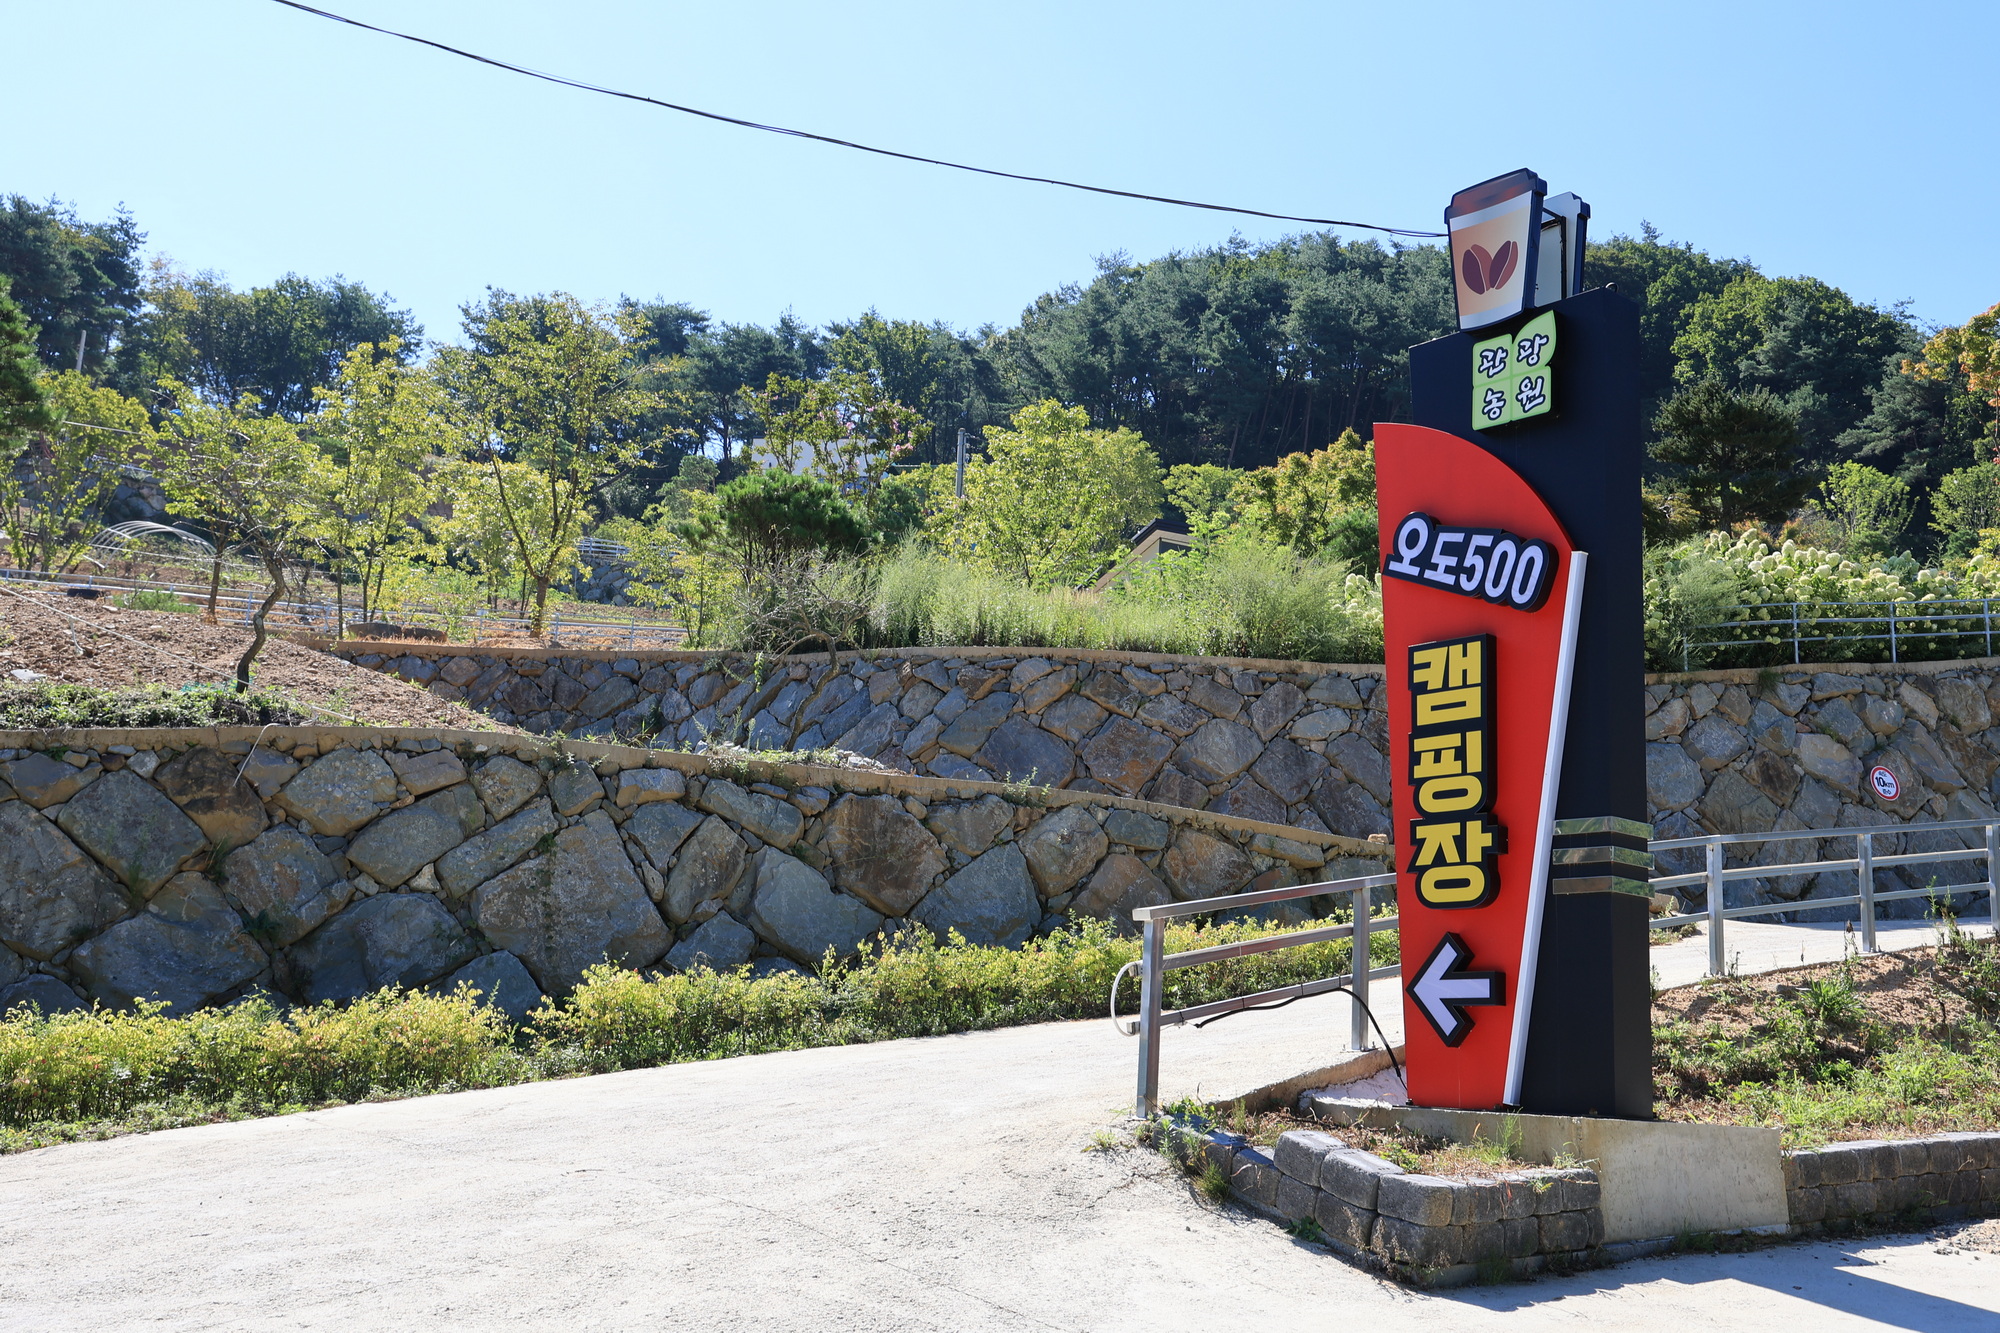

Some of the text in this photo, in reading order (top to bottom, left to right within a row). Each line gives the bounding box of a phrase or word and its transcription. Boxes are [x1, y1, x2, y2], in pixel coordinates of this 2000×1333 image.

[1479, 334, 1549, 377] 관광
[1482, 376, 1546, 420] 농원
[1387, 517, 1546, 605] 오도500
[1412, 640, 1493, 904] 캠핑장
[1875, 776, 1895, 789] 10km
